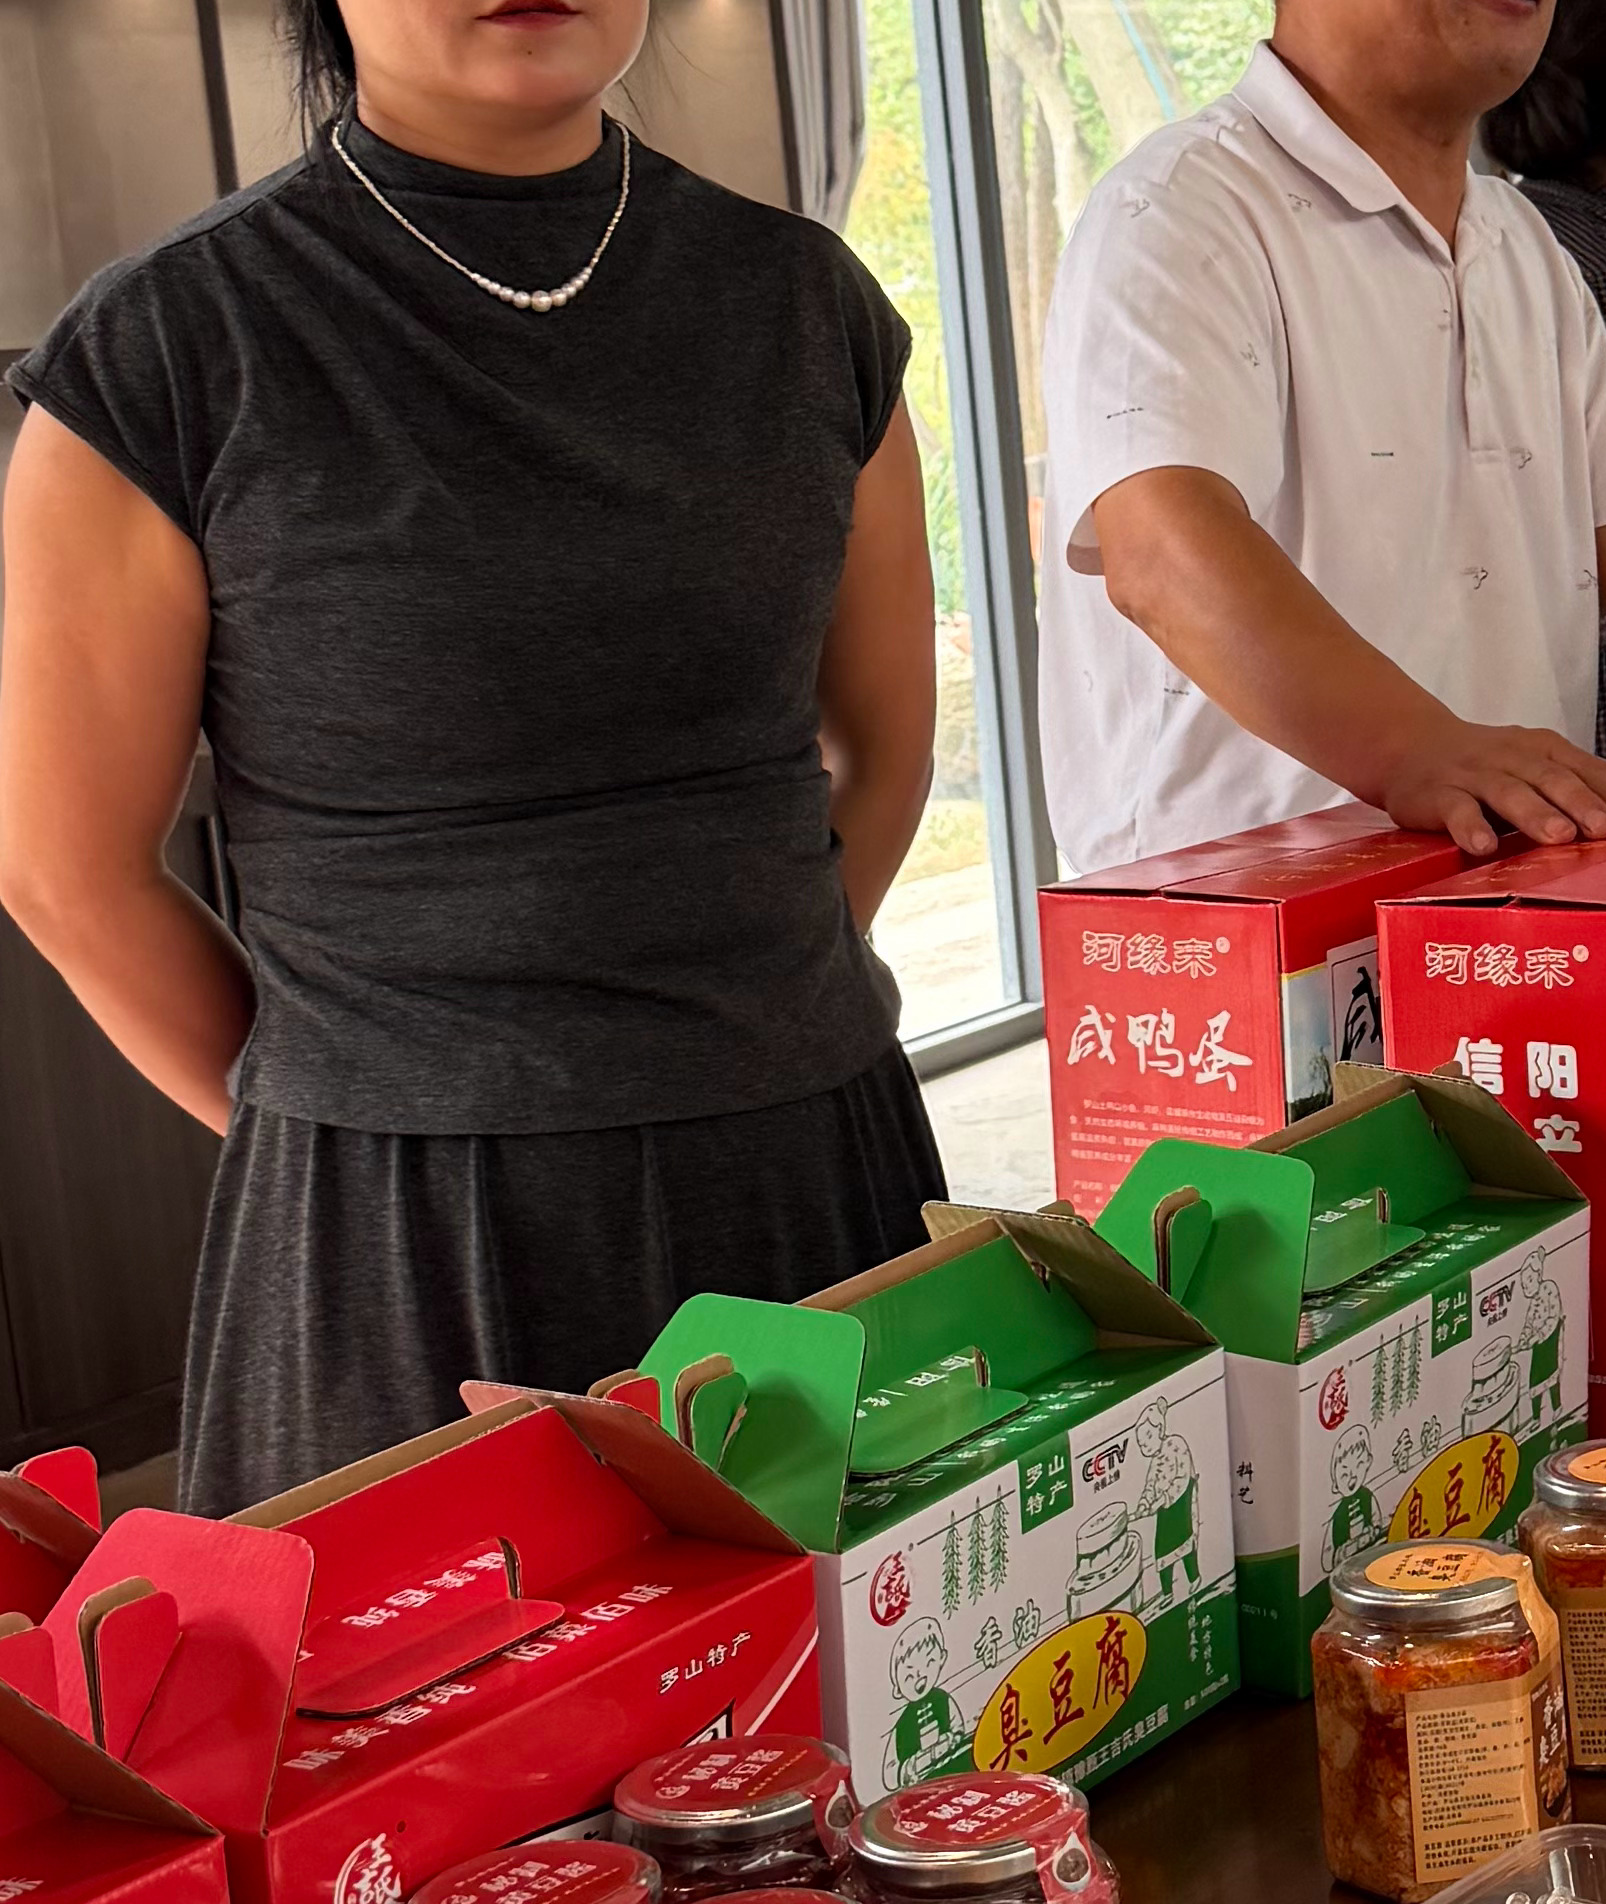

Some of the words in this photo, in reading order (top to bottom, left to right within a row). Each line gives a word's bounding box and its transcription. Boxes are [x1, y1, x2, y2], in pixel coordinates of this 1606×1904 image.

[1082, 931, 1217, 979] 河缘来
[1425, 942, 1576, 989] 河缘来
[1067, 1004, 1253, 1092] 咸鸭蛋
[1453, 1036, 1579, 1099] 信阳
[1026, 1455, 1065, 1490] 罗山
[1082, 1438, 1129, 1483] CCTV
[1026, 1481, 1067, 1516] 特产
[660, 1631, 751, 1693] 罗山特产
[974, 1599, 1041, 1670] 香油
[989, 1615, 1131, 1771] 臭豆腐
